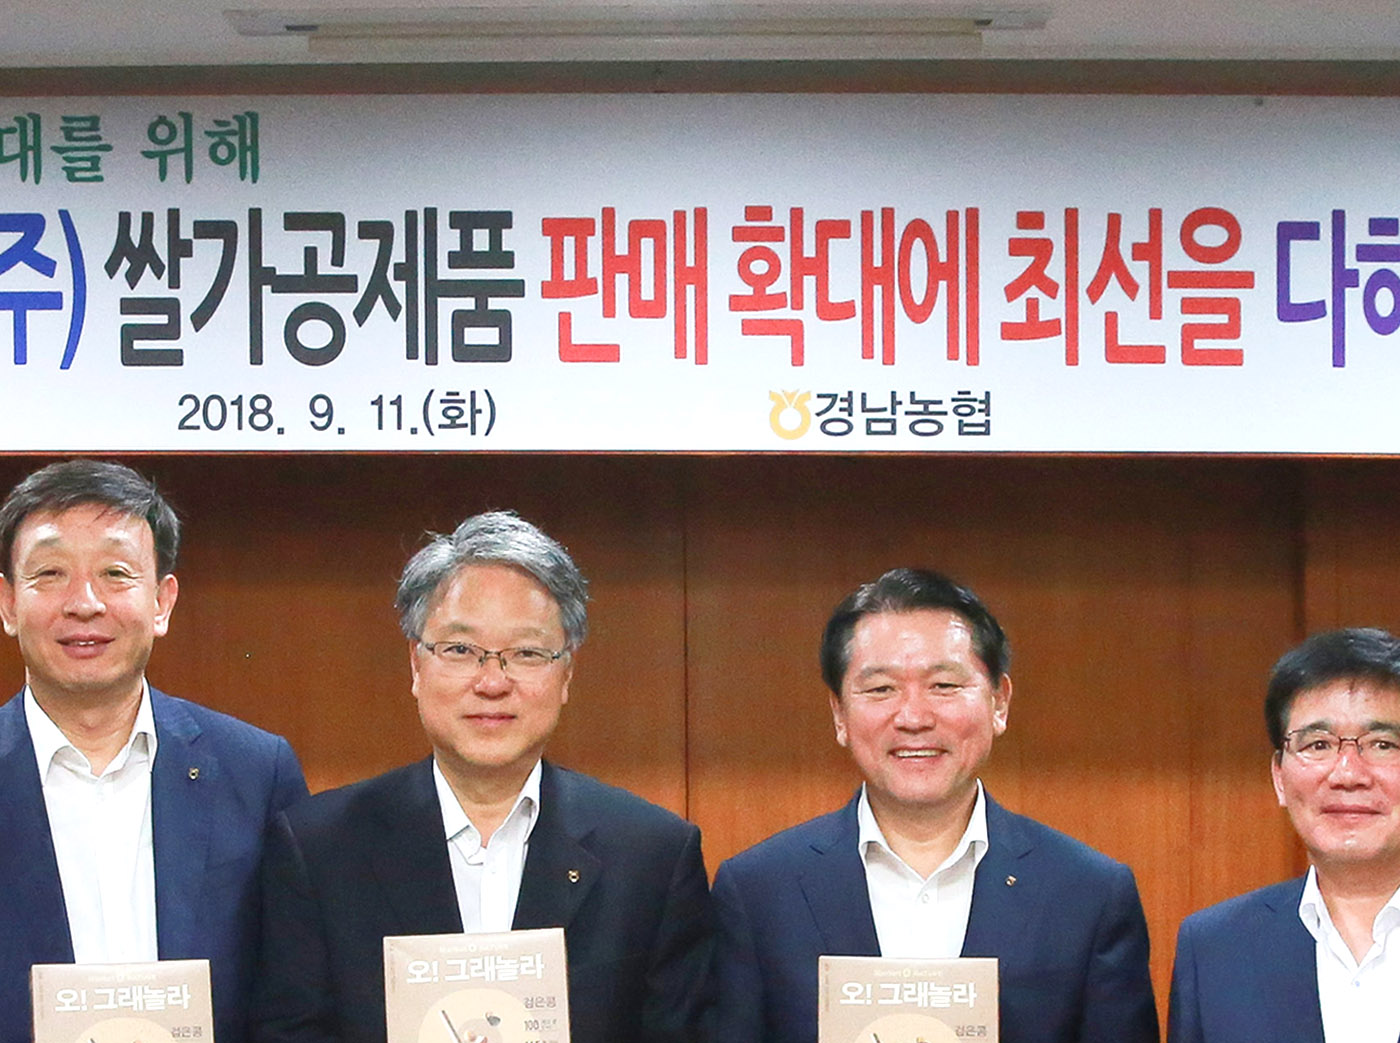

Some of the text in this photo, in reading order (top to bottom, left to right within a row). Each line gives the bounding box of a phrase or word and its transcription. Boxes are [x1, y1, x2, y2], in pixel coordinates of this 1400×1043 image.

[142, 113, 262, 184] 위해
[105, 207, 525, 366] 쌀가공제품
[541, 206, 708, 365] 판매
[728, 205, 979, 366] 확대에
[1000, 206, 1255, 366] 최선을
[177, 388, 496, 437] 2018. 9. 11.(화)
[815, 389, 992, 437] 경남농협
[406, 953, 545, 983] 오! 그래놀라
[55, 983, 192, 1012] 오! 그래놀라
[840, 982, 977, 1008] 오! 그래놀라
